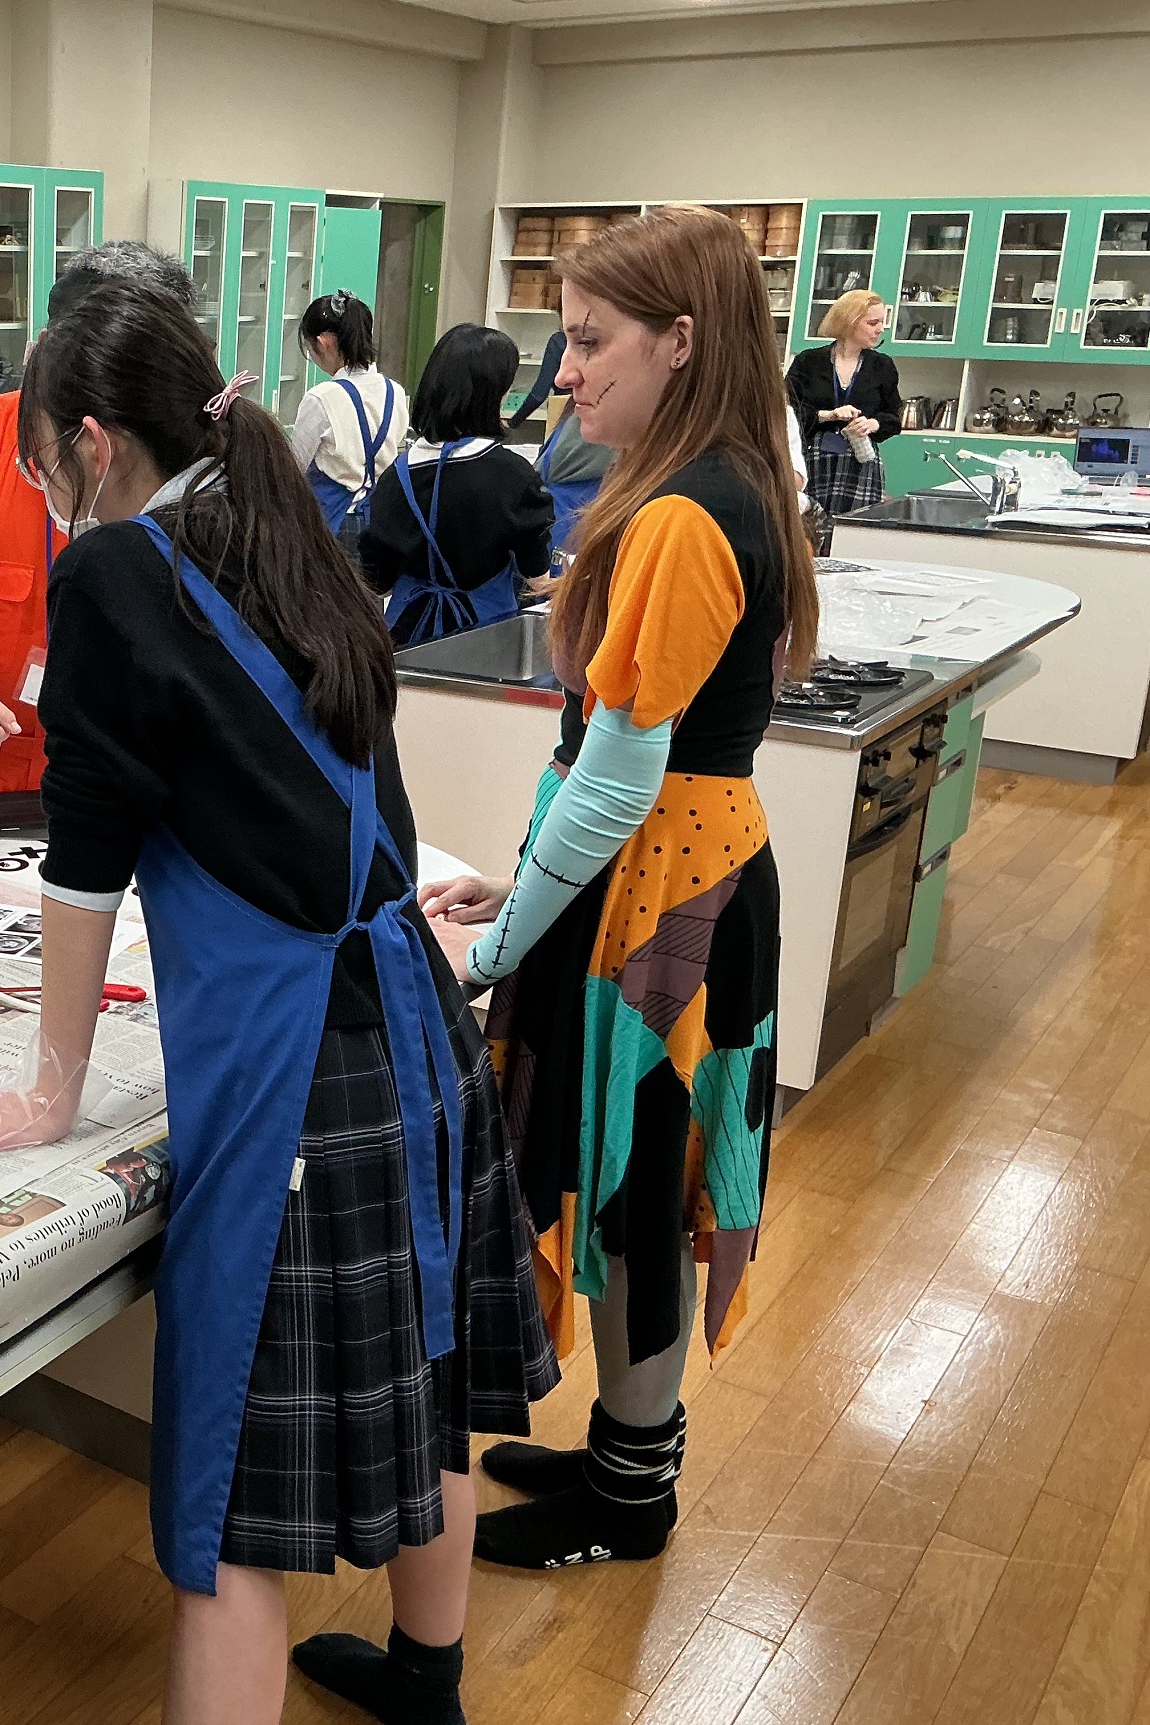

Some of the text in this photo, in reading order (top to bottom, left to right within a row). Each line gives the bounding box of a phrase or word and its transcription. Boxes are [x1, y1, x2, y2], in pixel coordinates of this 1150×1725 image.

[116, 1076, 161, 1095] how to
[94, 1193, 122, 1219] flood
[76, 1207, 91, 1226] of
[25, 1214, 77, 1243] tributes
[78, 1213, 123, 1244] Feuding
[8, 1239, 25, 1252] to
[60, 1238, 75, 1253] no
[23, 1246, 59, 1268] more,
